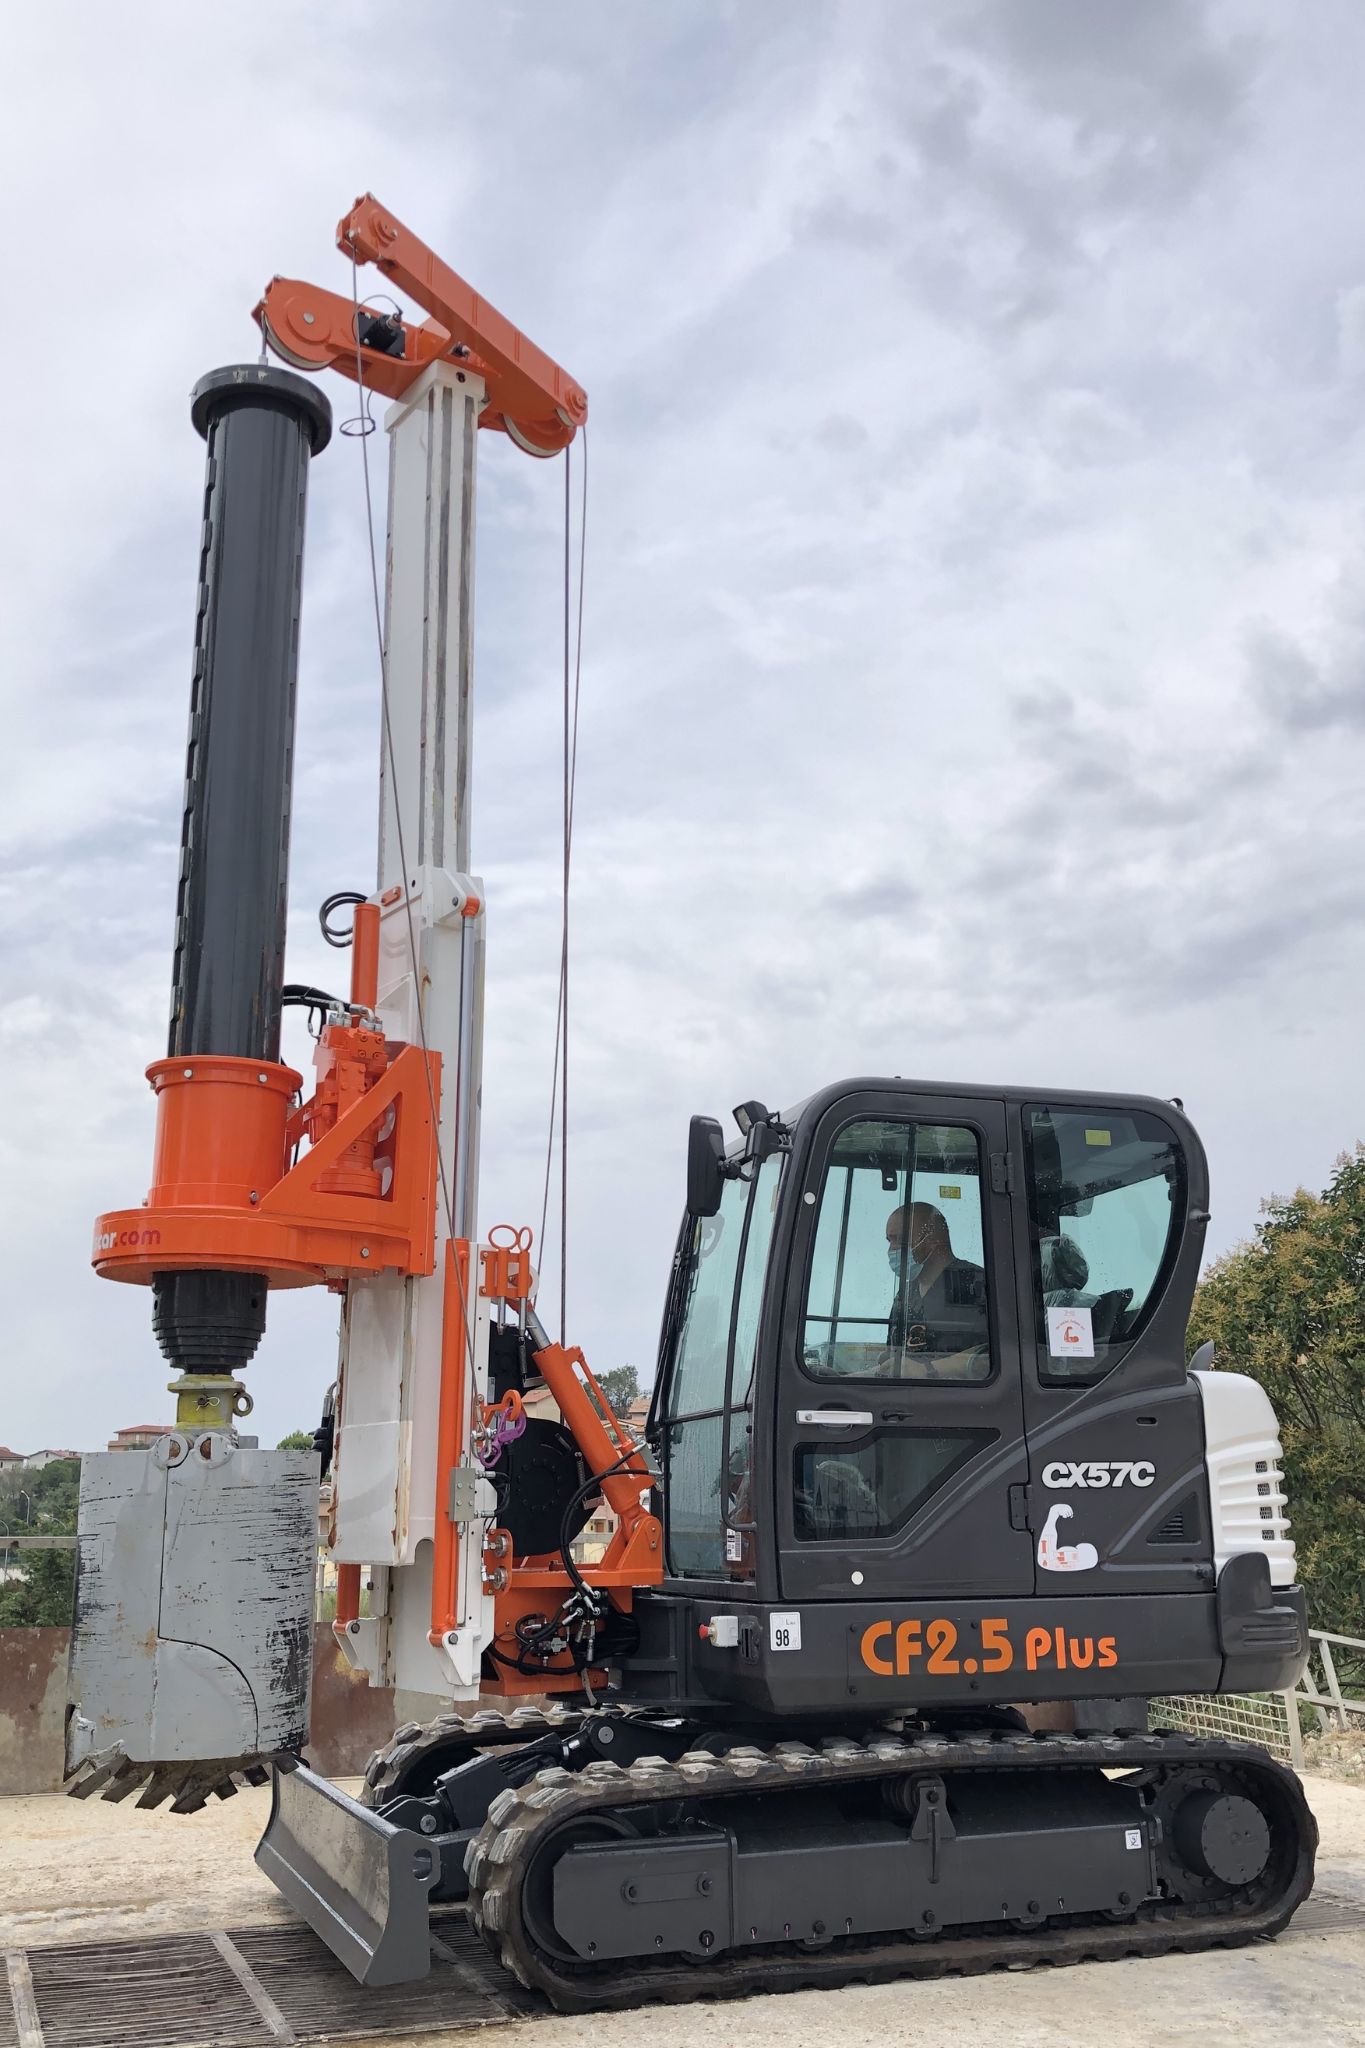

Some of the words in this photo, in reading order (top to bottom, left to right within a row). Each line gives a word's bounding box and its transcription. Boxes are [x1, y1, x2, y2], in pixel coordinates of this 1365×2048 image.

[1041, 1461, 1156, 1489] CX57C
[775, 1628, 790, 1647] 98
[860, 1618, 1014, 1676] CF2.5
[1025, 1626, 1118, 1671] Plus
